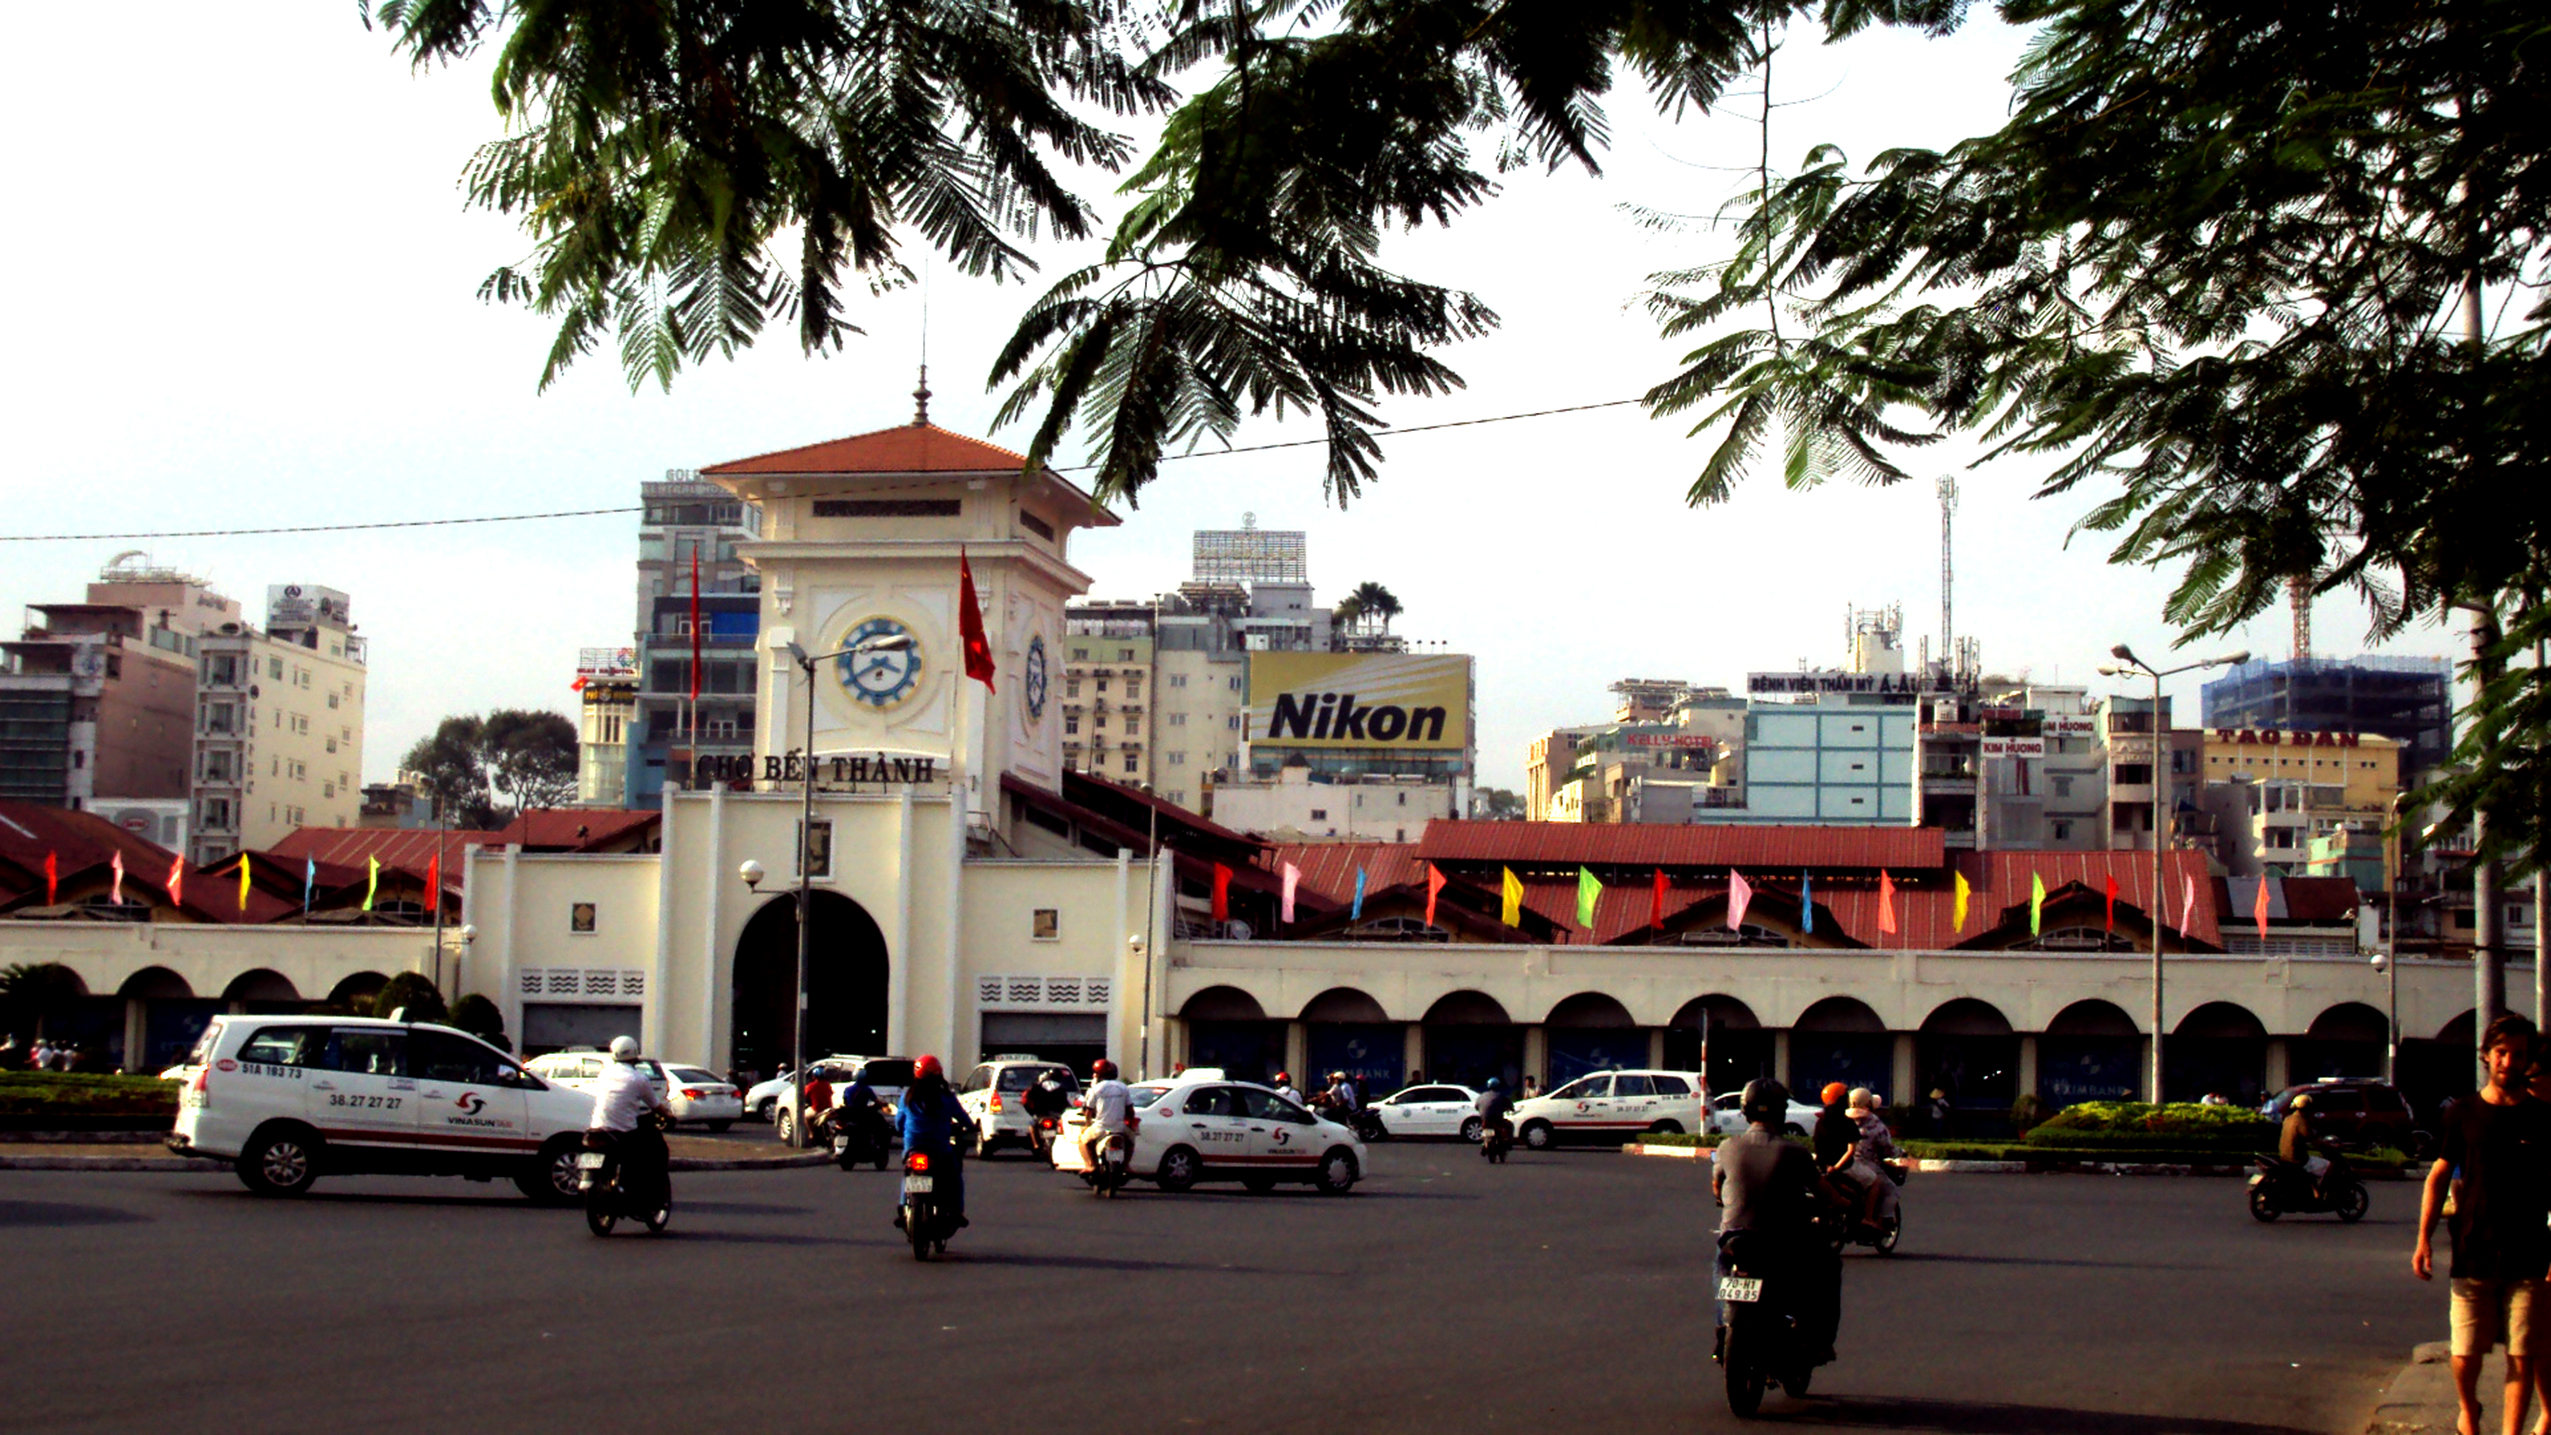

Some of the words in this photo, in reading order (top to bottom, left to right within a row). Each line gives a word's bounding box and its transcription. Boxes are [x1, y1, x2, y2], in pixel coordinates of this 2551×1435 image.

[1268, 692, 1446, 742] Nikon
[368, 1096, 384, 1108] 27
[387, 1097, 403, 1110] 27
